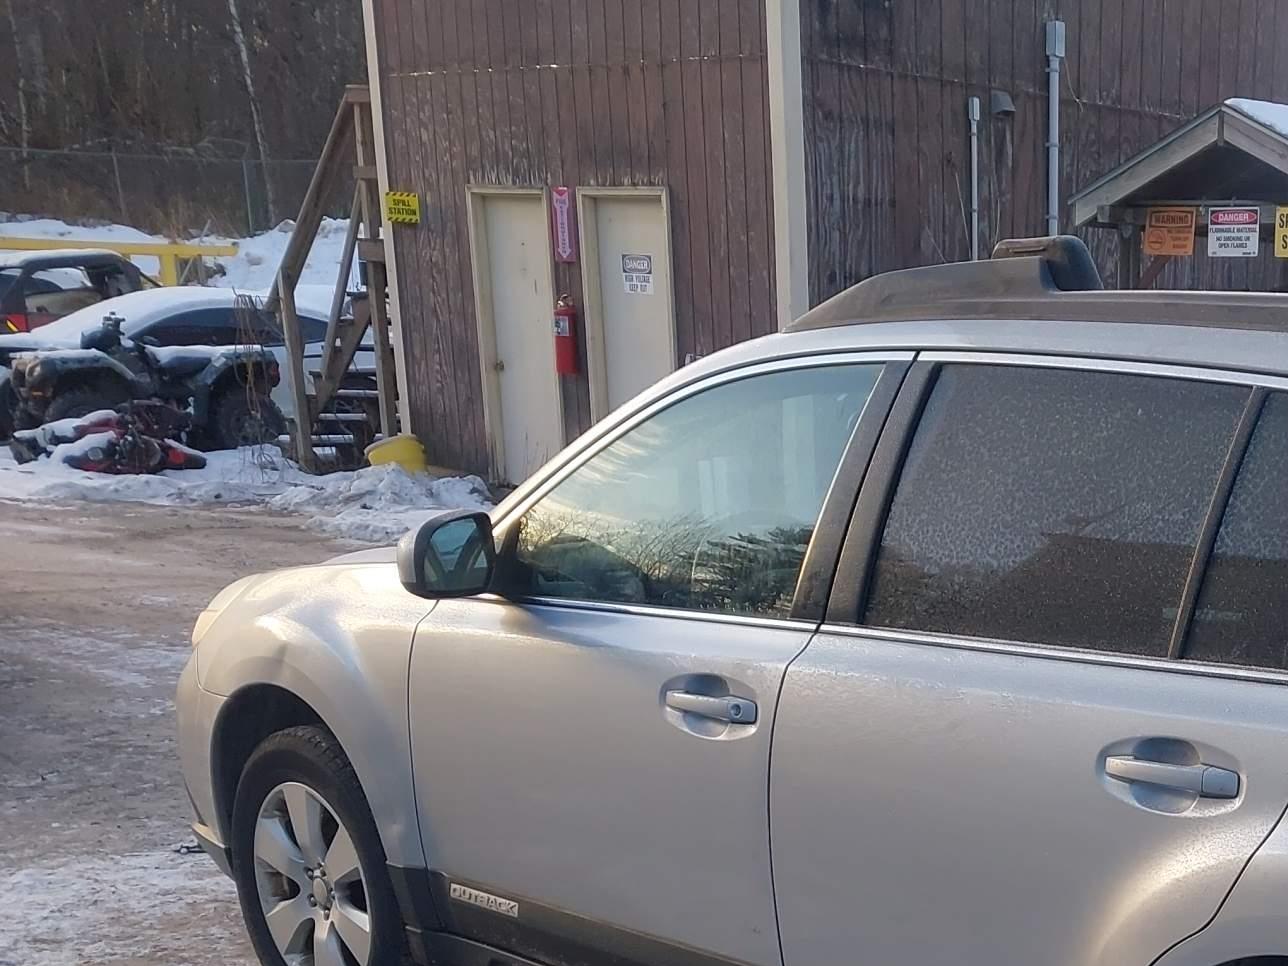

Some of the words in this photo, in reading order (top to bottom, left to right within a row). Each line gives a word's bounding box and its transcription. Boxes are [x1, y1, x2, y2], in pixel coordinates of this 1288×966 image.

[392, 198, 411, 207] SPILL
[389, 207, 417, 216] STATION
[1154, 214, 1190, 225] WARNING
[1218, 213, 1249, 222] DANGER
[625, 259, 649, 269] DANGER
[452, 886, 517, 915] OUTBACK
